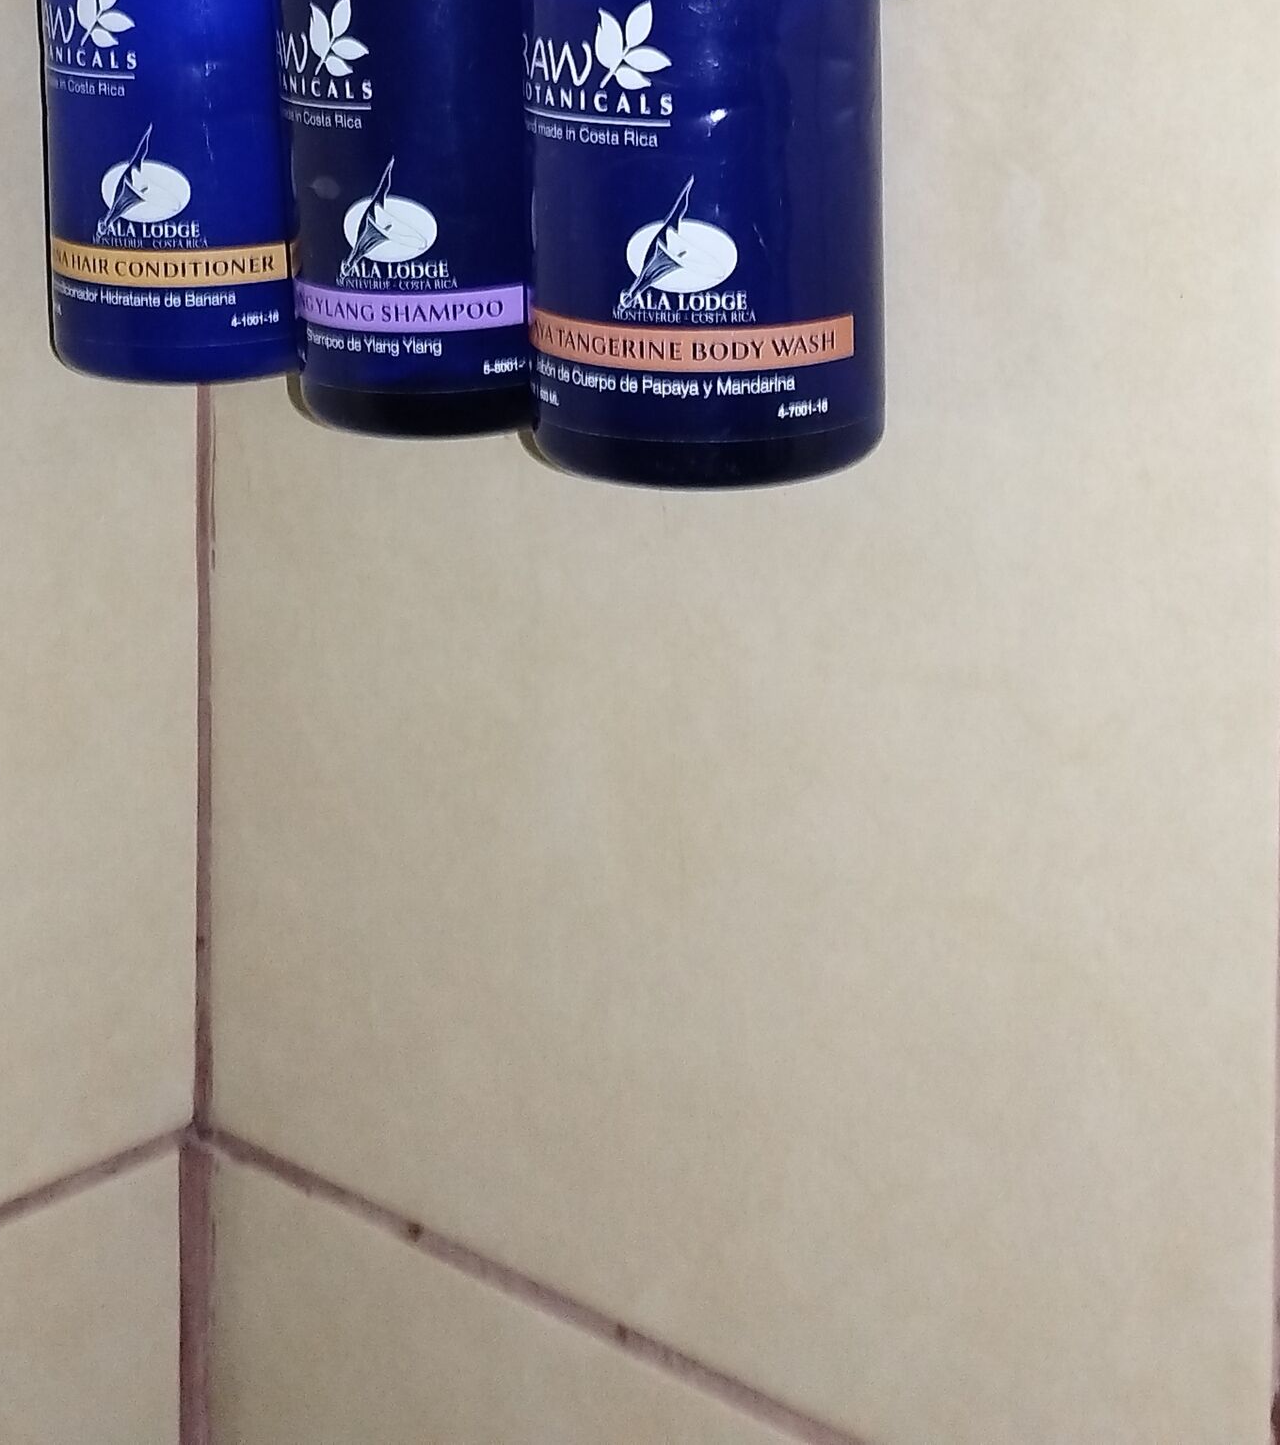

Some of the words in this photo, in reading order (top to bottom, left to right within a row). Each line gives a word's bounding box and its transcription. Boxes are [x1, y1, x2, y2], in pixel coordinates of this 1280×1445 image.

[67, 79, 96, 95] Costa
[98, 81, 126, 97] Rica
[278, 72, 373, 100] ANICALS
[522, 81, 673, 116] OTANICALS
[303, 111, 332, 128] Costa
[334, 112, 363, 130] Rica
[537, 123, 563, 140] made
[565, 125, 576, 141] in
[579, 127, 620, 146] Costa
[624, 129, 658, 148] Rica
[96, 220, 136, 238] CALA
[143, 220, 200, 239] LODGE
[71, 253, 109, 276] HAIR
[114, 254, 275, 278] CONDITIONER
[340, 260, 381, 279] CALA
[388, 259, 450, 279] LODGE
[398, 279, 431, 291] COSTA
[434, 277, 458, 290] RICA
[100, 289, 161, 308] Hidratante
[164, 289, 182, 308] de
[185, 289, 236, 309] Banana
[316, 297, 375, 322] YLANG
[381, 299, 504, 323] SHAMPOO
[619, 290, 672, 311] CALA
[678, 289, 748, 311] LODGE
[612, 308, 682, 324] MONTEVERDE
[691, 312, 729, 324] COSTA
[732, 311, 757, 323] RICA
[306, 326, 345, 351] Shampoo
[347, 335, 362, 352] de
[363, 335, 400, 356] Ylang
[402, 336, 442, 356] Ylang
[556, 328, 683, 361] TANGERINE
[691, 338, 767, 361] BODY
[770, 329, 837, 358] WASH
[557, 363, 570, 383] de
[571, 366, 617, 393] Cuerpo
[620, 373, 639, 394] de
[642, 375, 700, 399] Papaya
[703, 381, 713, 400] y
[716, 373, 796, 396] Mandarina
